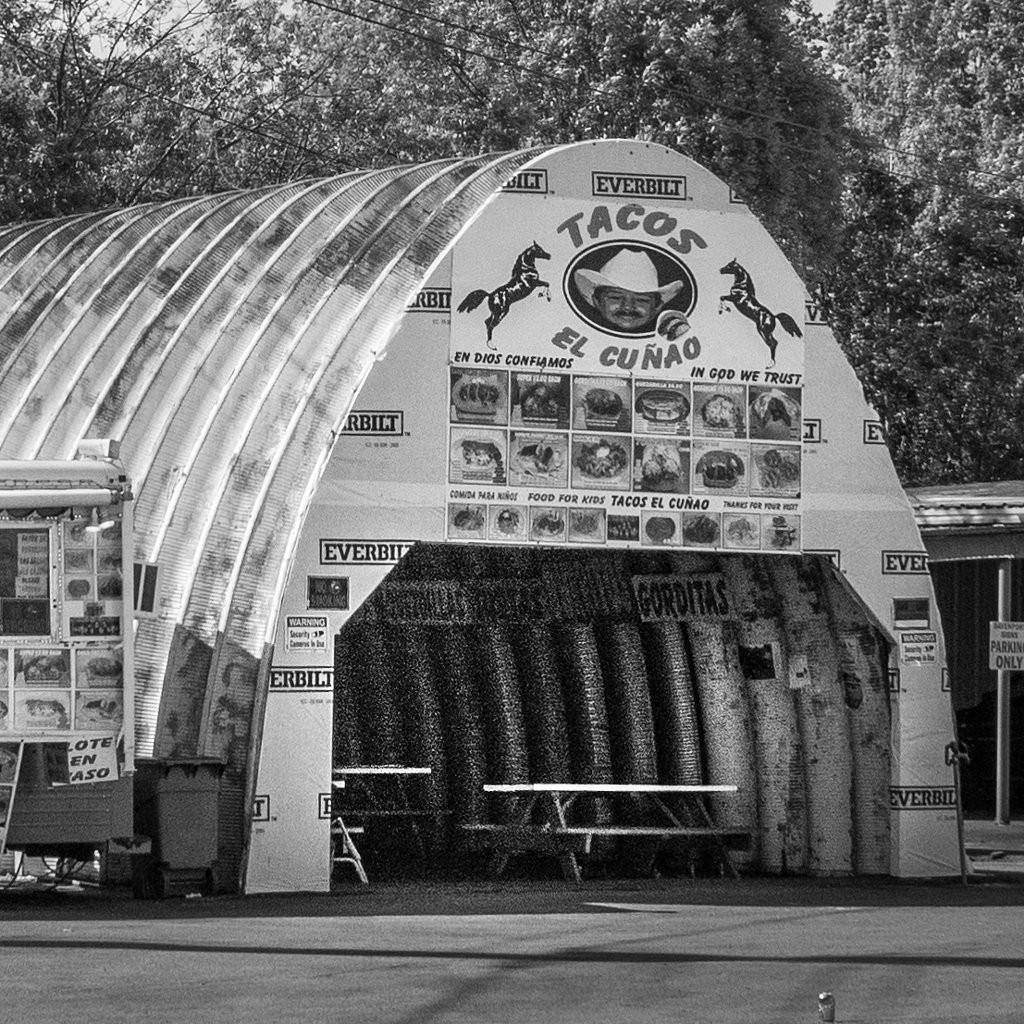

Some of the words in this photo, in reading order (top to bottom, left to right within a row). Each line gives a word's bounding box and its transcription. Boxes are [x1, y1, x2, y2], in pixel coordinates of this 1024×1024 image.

[596, 177, 683, 197] EVERBILT
[557, 204, 708, 254] TACOS
[551, 327, 589, 358] EL
[599, 337, 701, 370] CUÑAO
[454, 352, 470, 363] EN
[474, 353, 502, 364] DIOS
[505, 354, 574, 368] CONFIAMOS
[690, 367, 705, 378] IN
[709, 368, 735, 380] GOD
[740, 370, 760, 381] WE
[764, 371, 802, 385] TRUST
[341, 414, 398, 431] RBILT
[449, 490, 476, 499] COMIDA
[478, 491, 495, 500] PARA
[497, 490, 518, 501] NIÑOS
[528, 492, 555, 502] FOOD
[558, 494, 578, 503] FOR
[581, 495, 606, 504] KIDS
[611, 495, 648, 507] TACOS
[651, 496, 664, 508] EL
[668, 497, 710, 510] CUÑAO
[723, 500, 748, 509] THANKS
[749, 502, 762, 510] FOR
[764, 502, 782, 510] YOUR
[783, 503, 799, 511] VISIT
[289, 618, 325, 626] WARNING
[991, 640, 1024, 653] PARKIN
[996, 655, 1024, 669] ONLY
[68, 737, 113, 752] OTE
[70, 754, 97, 766] EN
[70, 767, 110, 781] ASO
